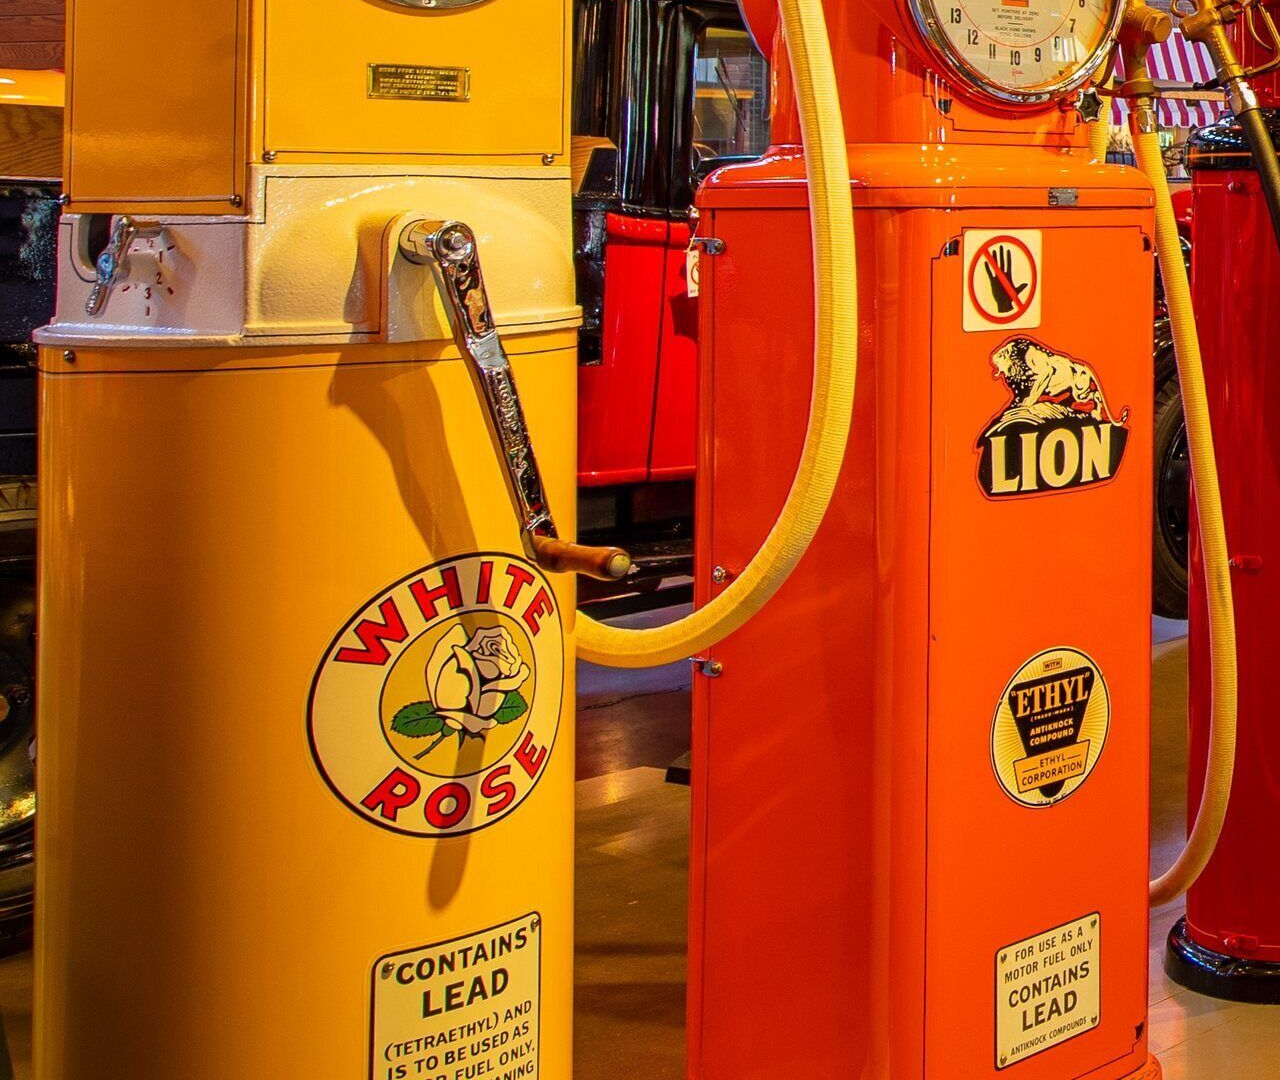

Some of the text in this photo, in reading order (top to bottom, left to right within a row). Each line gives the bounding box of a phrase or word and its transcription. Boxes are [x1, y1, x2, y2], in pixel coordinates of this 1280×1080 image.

[989, 423, 1112, 494] LION
[333, 561, 555, 666] WHITE
[1044, 660, 1062, 669] WITH
[1029, 717, 1074, 737] ANTIKNOCK
[1029, 727, 1074, 747] COMPOUND
[360, 730, 548, 830] ROSE
[1021, 760, 1083, 786] CORPORATION
[1039, 753, 1067, 768] ETHYL
[395, 926, 528, 985] CONTAINS
[1004, 938, 1094, 984] MOTOR FUEL ONLY
[1014, 926, 1083, 962] FOR USE AS A
[422, 967, 509, 1019] LEAD
[1008, 960, 1090, 1008] CONTAINS
[384, 999, 532, 1062] (TETRAETHYL) AND
[1022, 989, 1077, 1032] LEAD
[387, 1020, 530, 1080] IS TO BE USED AS
[499, 1039, 536, 1066] ONLY.
[1010, 1016, 1087, 1057] ANTIKNOCK COMPOUNDS
